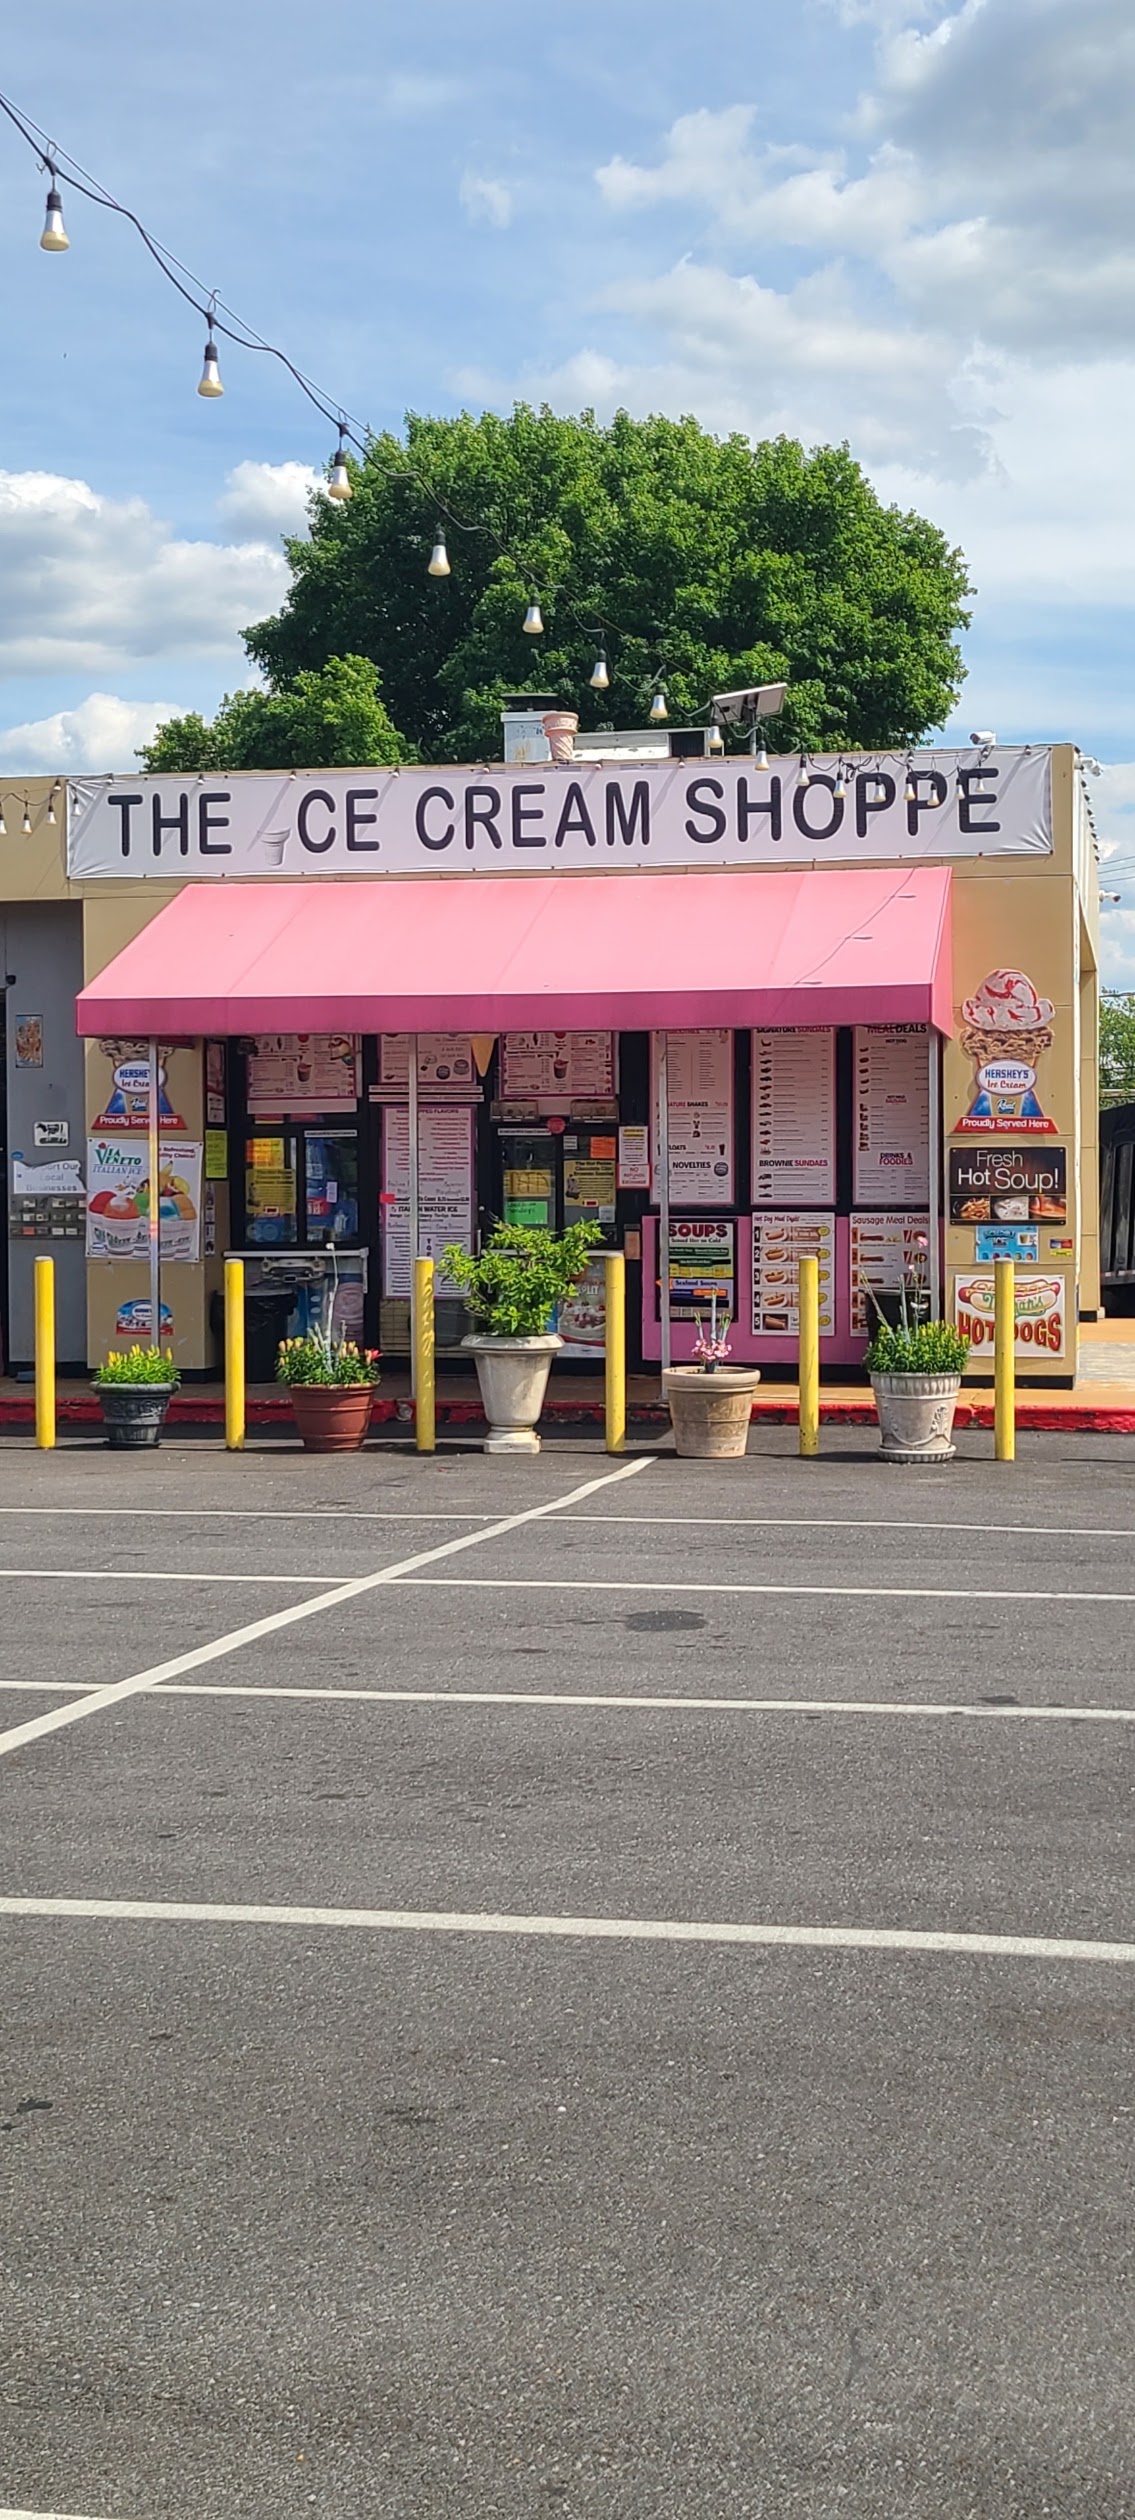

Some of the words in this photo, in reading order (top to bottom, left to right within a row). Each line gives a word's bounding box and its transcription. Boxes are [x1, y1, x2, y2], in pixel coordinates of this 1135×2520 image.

[107, 794, 231, 858] THE
[416, 781, 651, 852] CREAM
[684, 768, 1001, 844] SHOPPE
[895, 1024, 927, 1033] DEALS
[985, 1069, 1029, 1079] HERSHEY'S
[987, 1080, 999, 1089] Ice
[999, 1080, 1027, 1089] Cream
[99, 1115, 130, 1126] Proudly
[159, 1116, 179, 1125] Here
[962, 1118, 995, 1129] Proudly
[997, 1118, 1027, 1128] Served
[1029, 1118, 1050, 1128] Here
[759, 1159, 793, 1167] BROWNIE
[794, 1159, 828, 1167] SUNDAES
[976, 1150, 1024, 1167] Fresh
[62, 1162, 79, 1171] Our
[92, 1165, 127, 1174] ITALIAN
[957, 1168, 991, 1186] Hot
[994, 1168, 1059, 1193] Soup!
[852, 1216, 884, 1225] Sausage
[886, 1216, 905, 1224] Meal
[669, 1223, 728, 1238] SOUPS
